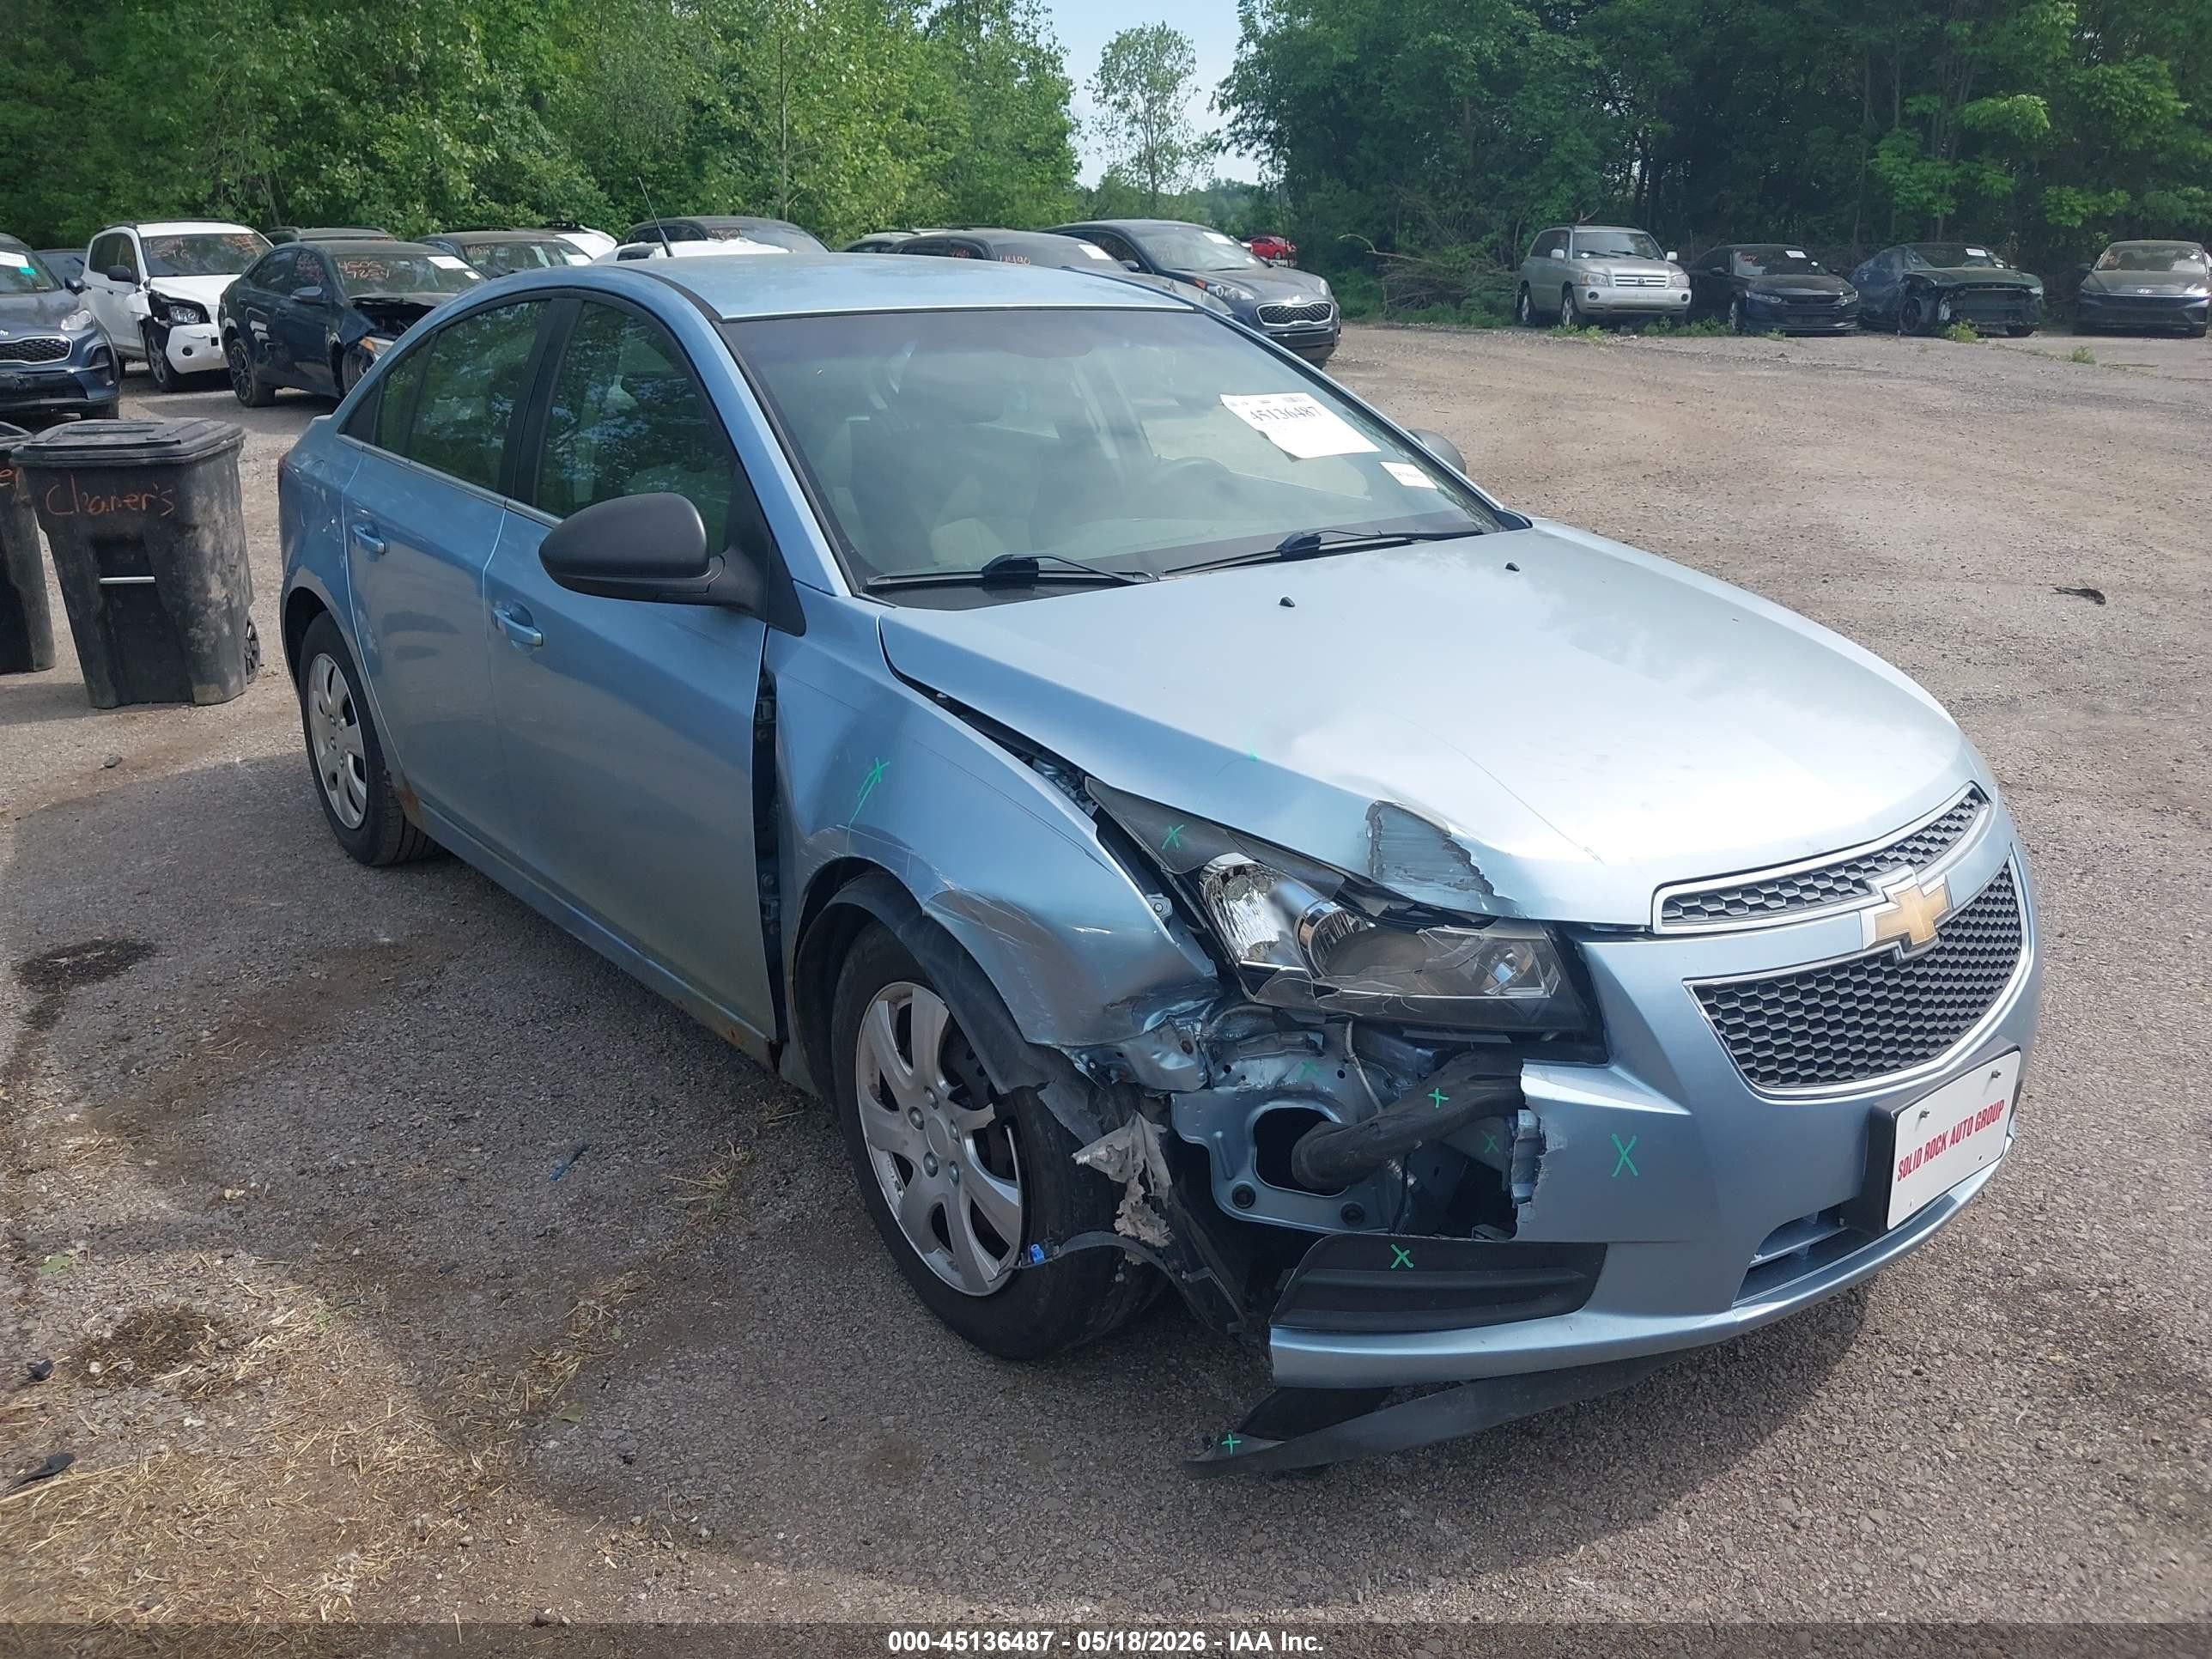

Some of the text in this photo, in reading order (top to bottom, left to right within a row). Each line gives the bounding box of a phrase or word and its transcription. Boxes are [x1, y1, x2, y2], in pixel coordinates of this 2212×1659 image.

[1249, 406, 1322, 422] 45136487
[1897, 1099, 2005, 1182] SOLID ROCK AUTO GROUP
